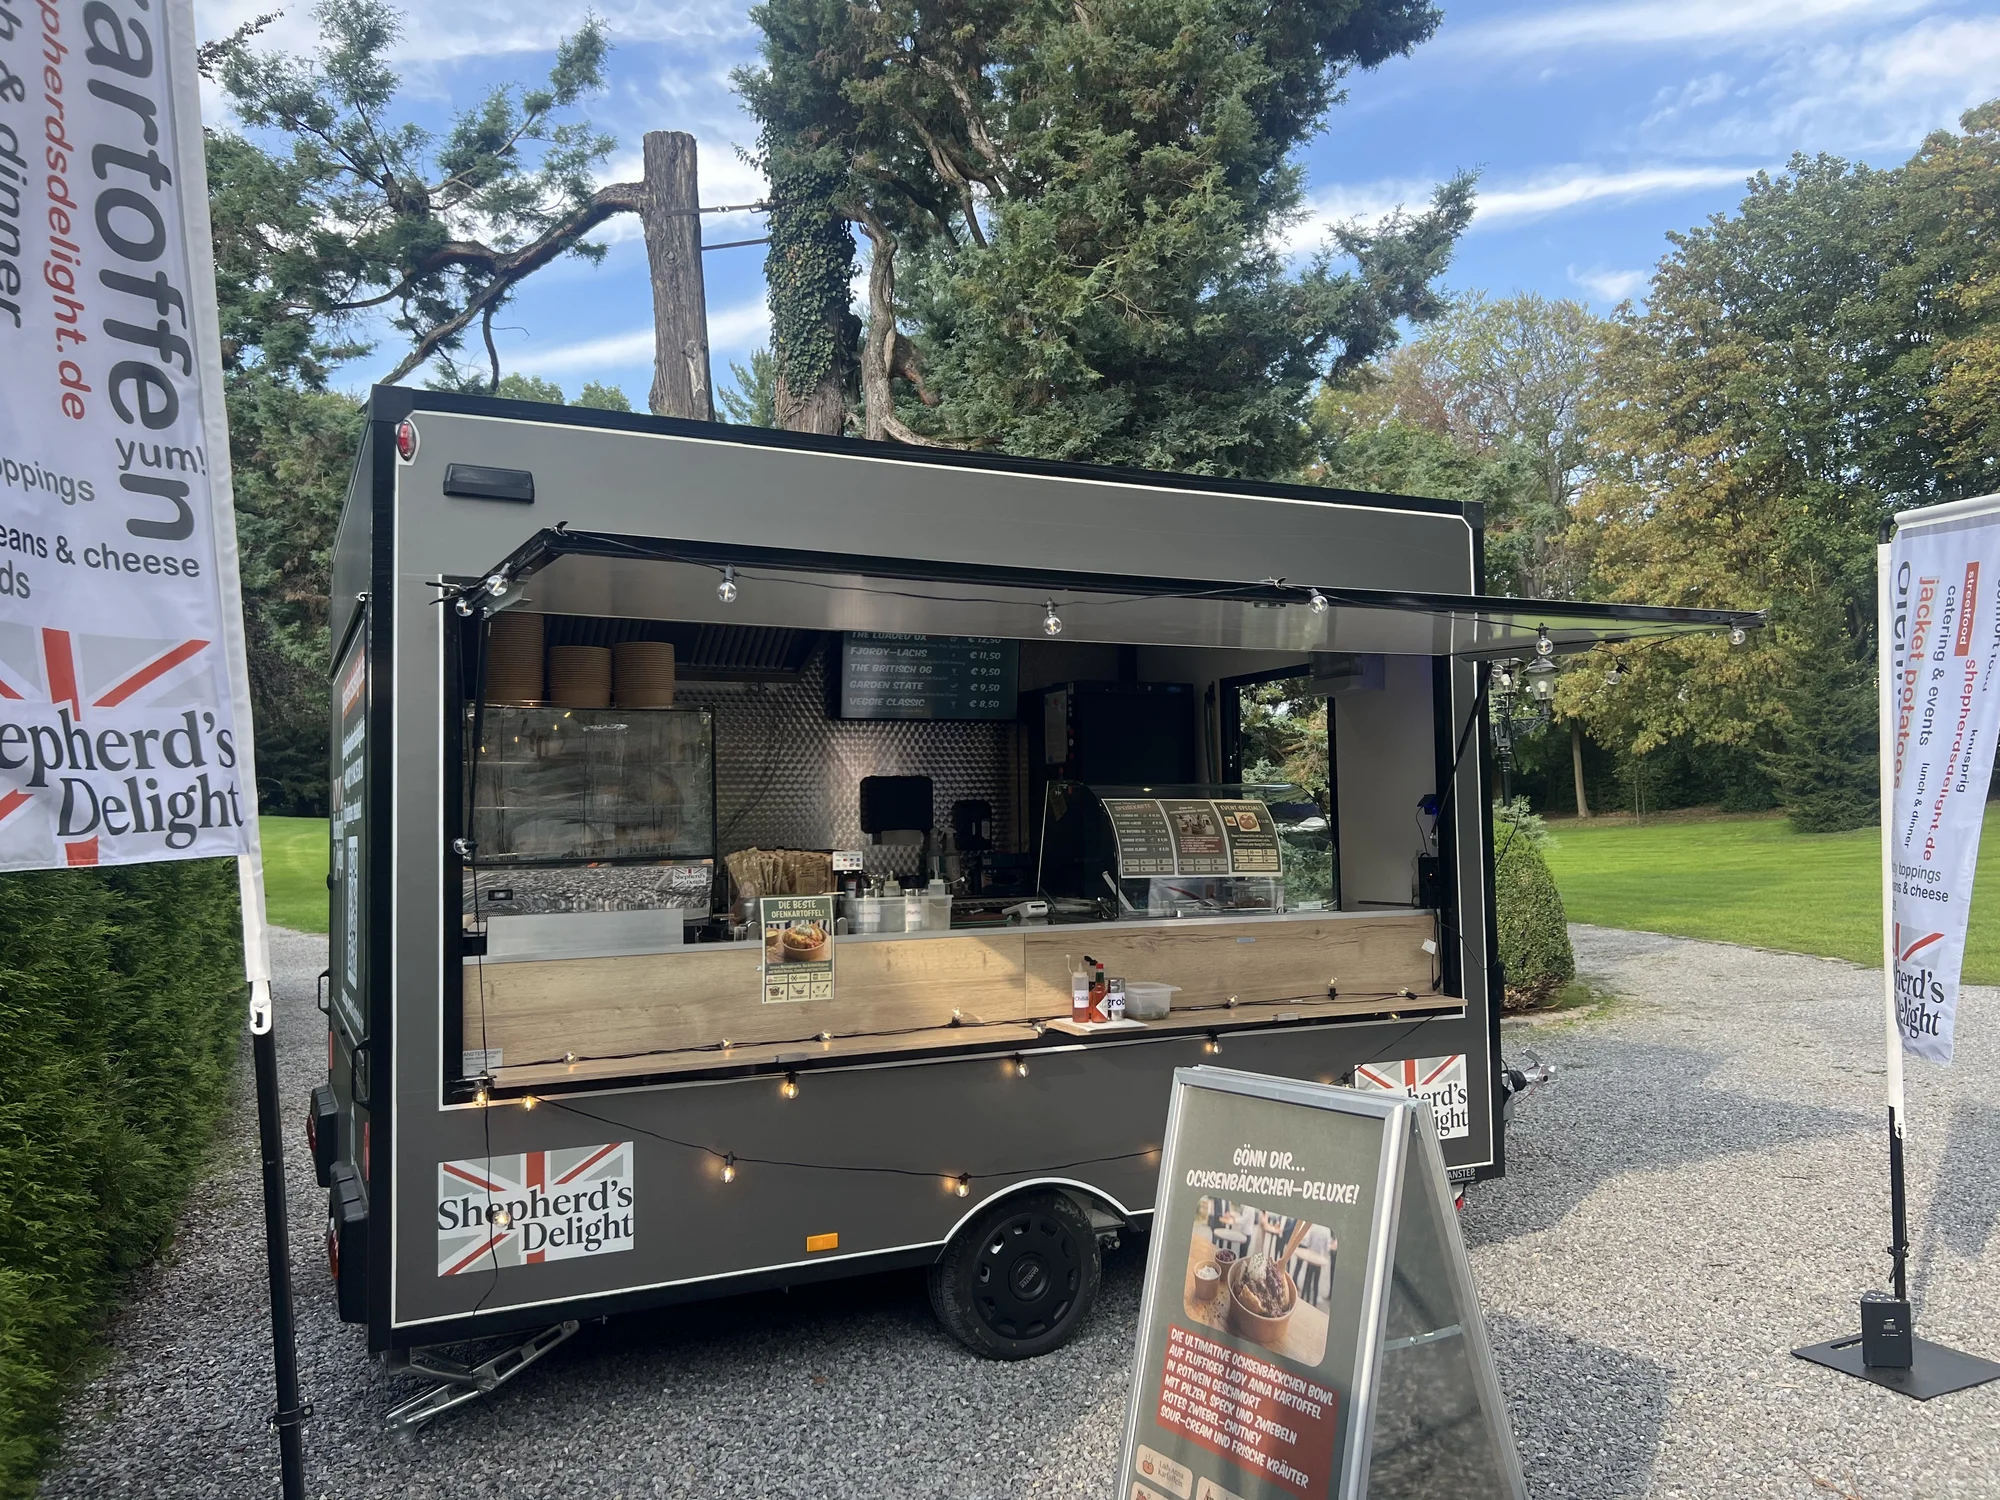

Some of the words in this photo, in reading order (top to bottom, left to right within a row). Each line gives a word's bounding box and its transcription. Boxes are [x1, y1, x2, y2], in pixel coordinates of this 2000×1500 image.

[36, 0, 92, 420] pherdsdelight.de
[115, 438, 206, 476] yum!
[0, 457, 95, 506] ppings
[56, 535, 76, 565] &
[84, 543, 200, 577] cheese
[1909, 577, 1940, 662] jacket
[1932, 585, 1956, 661] catering
[1959, 570, 1975, 645] streetfood
[851, 664, 869, 672] THE
[872, 664, 917, 674] BRITISCH
[919, 665, 932, 674] OG
[980, 668, 1000, 676] 9,50
[979, 652, 1001, 660] 11,50
[1931, 668, 1945, 681] &
[849, 680, 890, 689] GARDEN
[892, 681, 924, 690] STATE
[979, 684, 1000, 692] 9,50
[849, 697, 884, 706] VEGGIE
[886, 698, 925, 707] CLASSIC
[969, 700, 977, 708] €
[979, 700, 999, 709] 8,50
[1894, 669, 1918, 789] potatoes
[1919, 686, 1939, 746] events
[1916, 762, 1930, 795] lunch
[1923, 659, 1978, 860] shepherdsdelight.de
[1956, 729, 1978, 792] knusprig
[57, 773, 244, 849] Delight
[1914, 799, 1922, 807] &
[1898, 861, 1942, 884] toppings
[1902, 881, 1908, 895] &
[1910, 884, 1949, 903] cheese
[771, 909, 825, 918] OFENKARTOFFEL!
[778, 900, 791, 909] DIE
[793, 899, 817, 909] BESTE
[1895, 959, 1945, 1004] herd's
[1899, 996, 1941, 1039] elight
[1434, 1107, 1469, 1137] ight
[1233, 1144, 1268, 1168] GÖNN
[1269, 1151, 1306, 1172] DIR...
[1186, 1169, 1360, 1205] OCHSENBÄCKCHEN-DELUXE!
[522, 1212, 634, 1251] Delight
[1166, 1358, 1176, 1372] IN
[1176, 1363, 1212, 1388] ROTWEIN
[1212, 1378, 1262, 1410] GESCHMORT
[1168, 1344, 1185, 1359] AUF
[1185, 1350, 1224, 1377] FLUFFIGER
[1225, 1367, 1248, 1386] LADY
[1248, 1377, 1272, 1398] ANNA
[1273, 1387, 1321, 1420] KARTOFFEL
[1171, 1328, 1185, 1343] DIE
[1185, 1333, 1231, 1362] ULTIMATIVE
[1232, 1353, 1307, 1394] OCHSENBÄCKCHEN
[1307, 1384, 1334, 1406] BOWL
[1162, 1389, 1188, 1410] ROTES
[1187, 1401, 1262, 1446] ZWIEBEL-CHUTNEY
[1164, 1373, 1180, 1389] MIT
[1180, 1381, 1207, 1405] PILZEN,
[1209, 1393, 1236, 1416] SPECK
[1235, 1406, 1254, 1424] UND
[1254, 1415, 1297, 1445] ZWIEBELN
[1160, 1404, 1213, 1440] SOUR-CREAM
[1213, 1430, 1230, 1448] UND
[1231, 1440, 1266, 1467] FRISCHE
[1266, 1457, 1309, 1488] KRÄUTER
